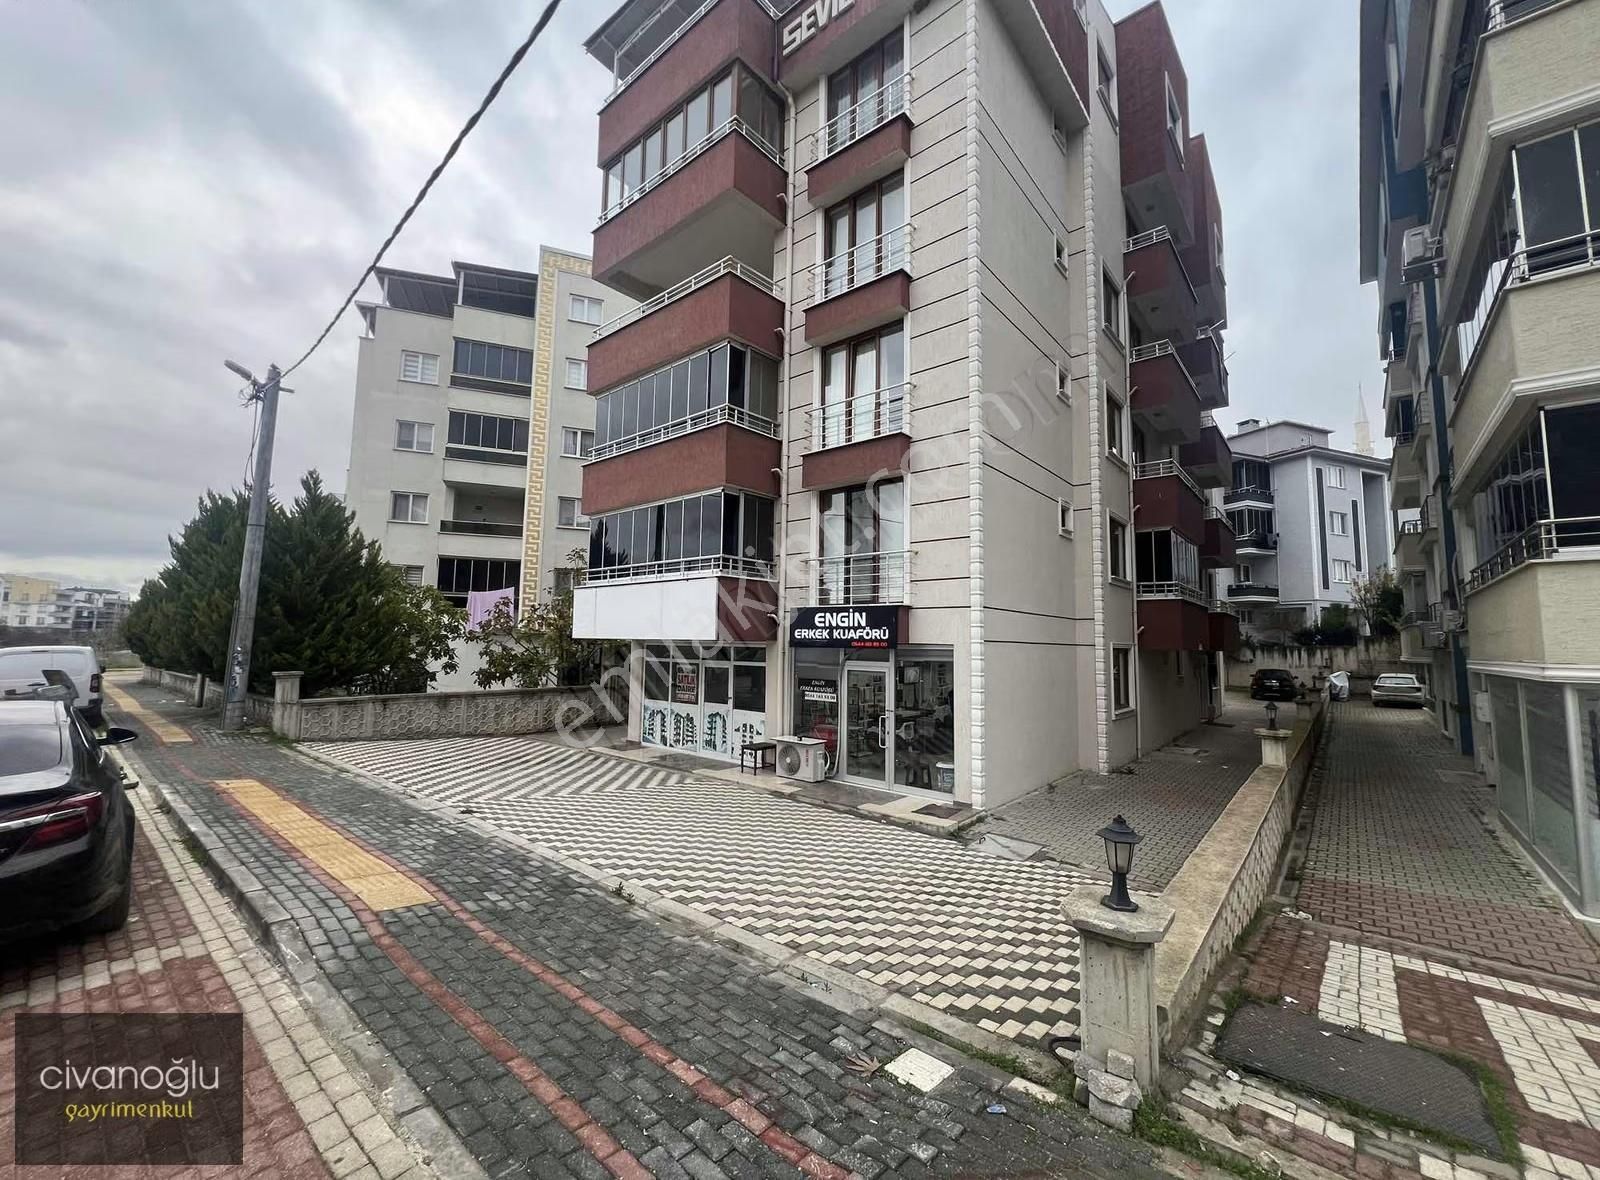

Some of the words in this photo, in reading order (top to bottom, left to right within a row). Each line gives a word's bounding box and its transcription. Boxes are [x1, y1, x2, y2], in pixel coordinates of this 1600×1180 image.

[814, 608, 866, 627] ENGİN
[794, 629, 830, 639] ERKEK
[833, 626, 889, 640] KUAFÖRÜ
